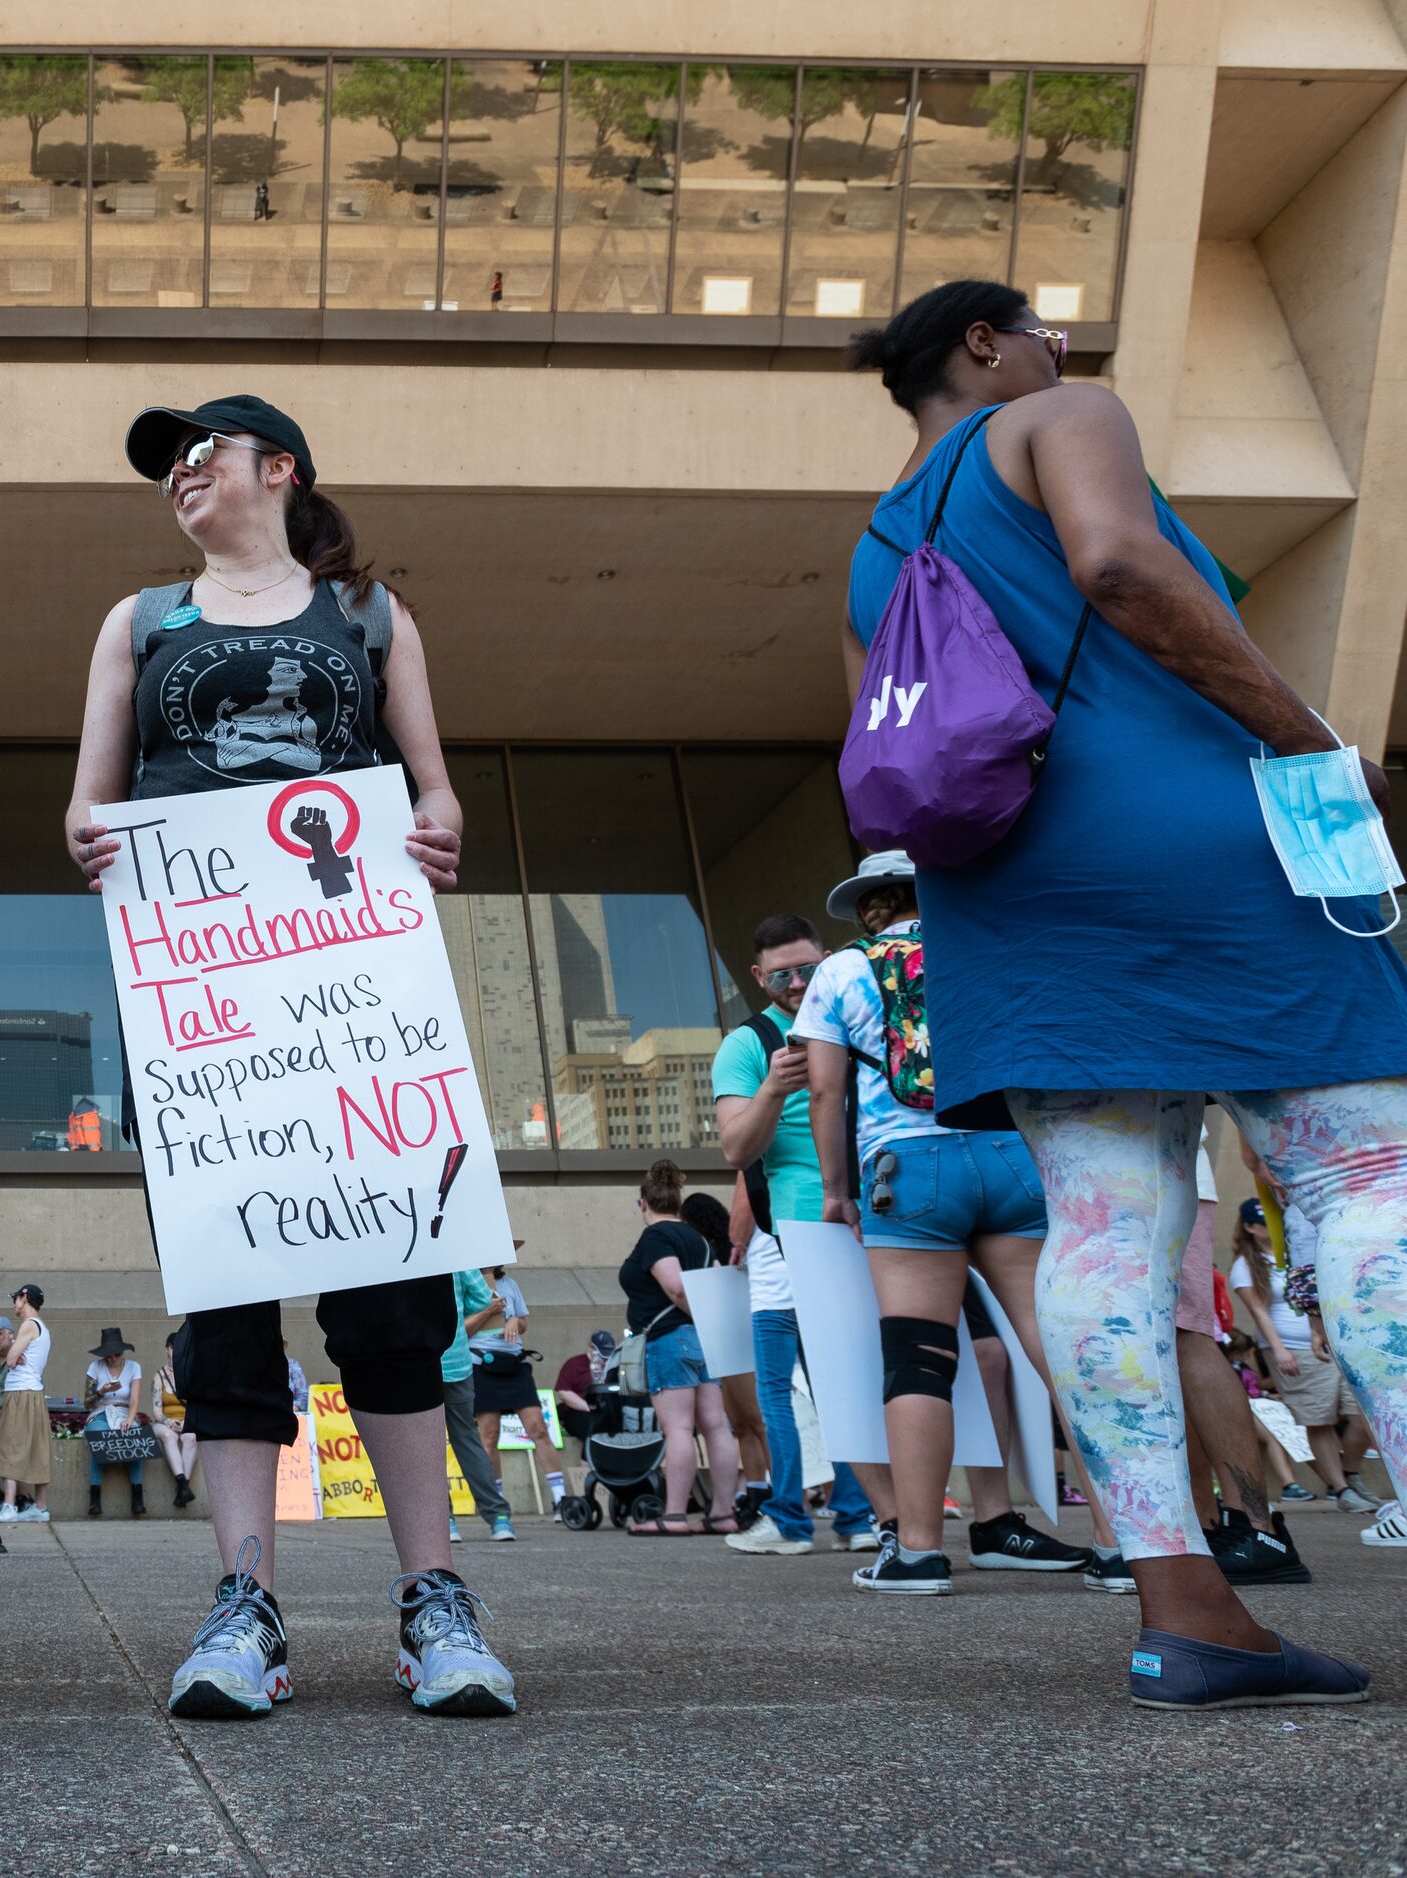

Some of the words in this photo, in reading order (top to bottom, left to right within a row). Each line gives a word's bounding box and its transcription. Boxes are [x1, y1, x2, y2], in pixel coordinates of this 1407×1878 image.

[200, 639, 315, 660] TREAD
[327, 656, 356, 692] ON
[105, 818, 249, 901] The
[119, 857, 423, 976] Handmaid's
[131, 975, 254, 1048] Tale
[281, 973, 382, 1026] was
[342, 1021, 387, 1063] to
[396, 1011, 447, 1056] be
[154, 1107, 334, 1177] fiction,
[337, 1067, 468, 1162] NOT
[89, 1437, 156, 1452] BREEDING
[101, 1431, 119, 1439] I'M
[121, 1427, 143, 1437] NOT
[105, 1446, 155, 1461] STOCK
[317, 1435, 362, 1465] NOT
[1136, 1659, 1155, 1669] TOMS
